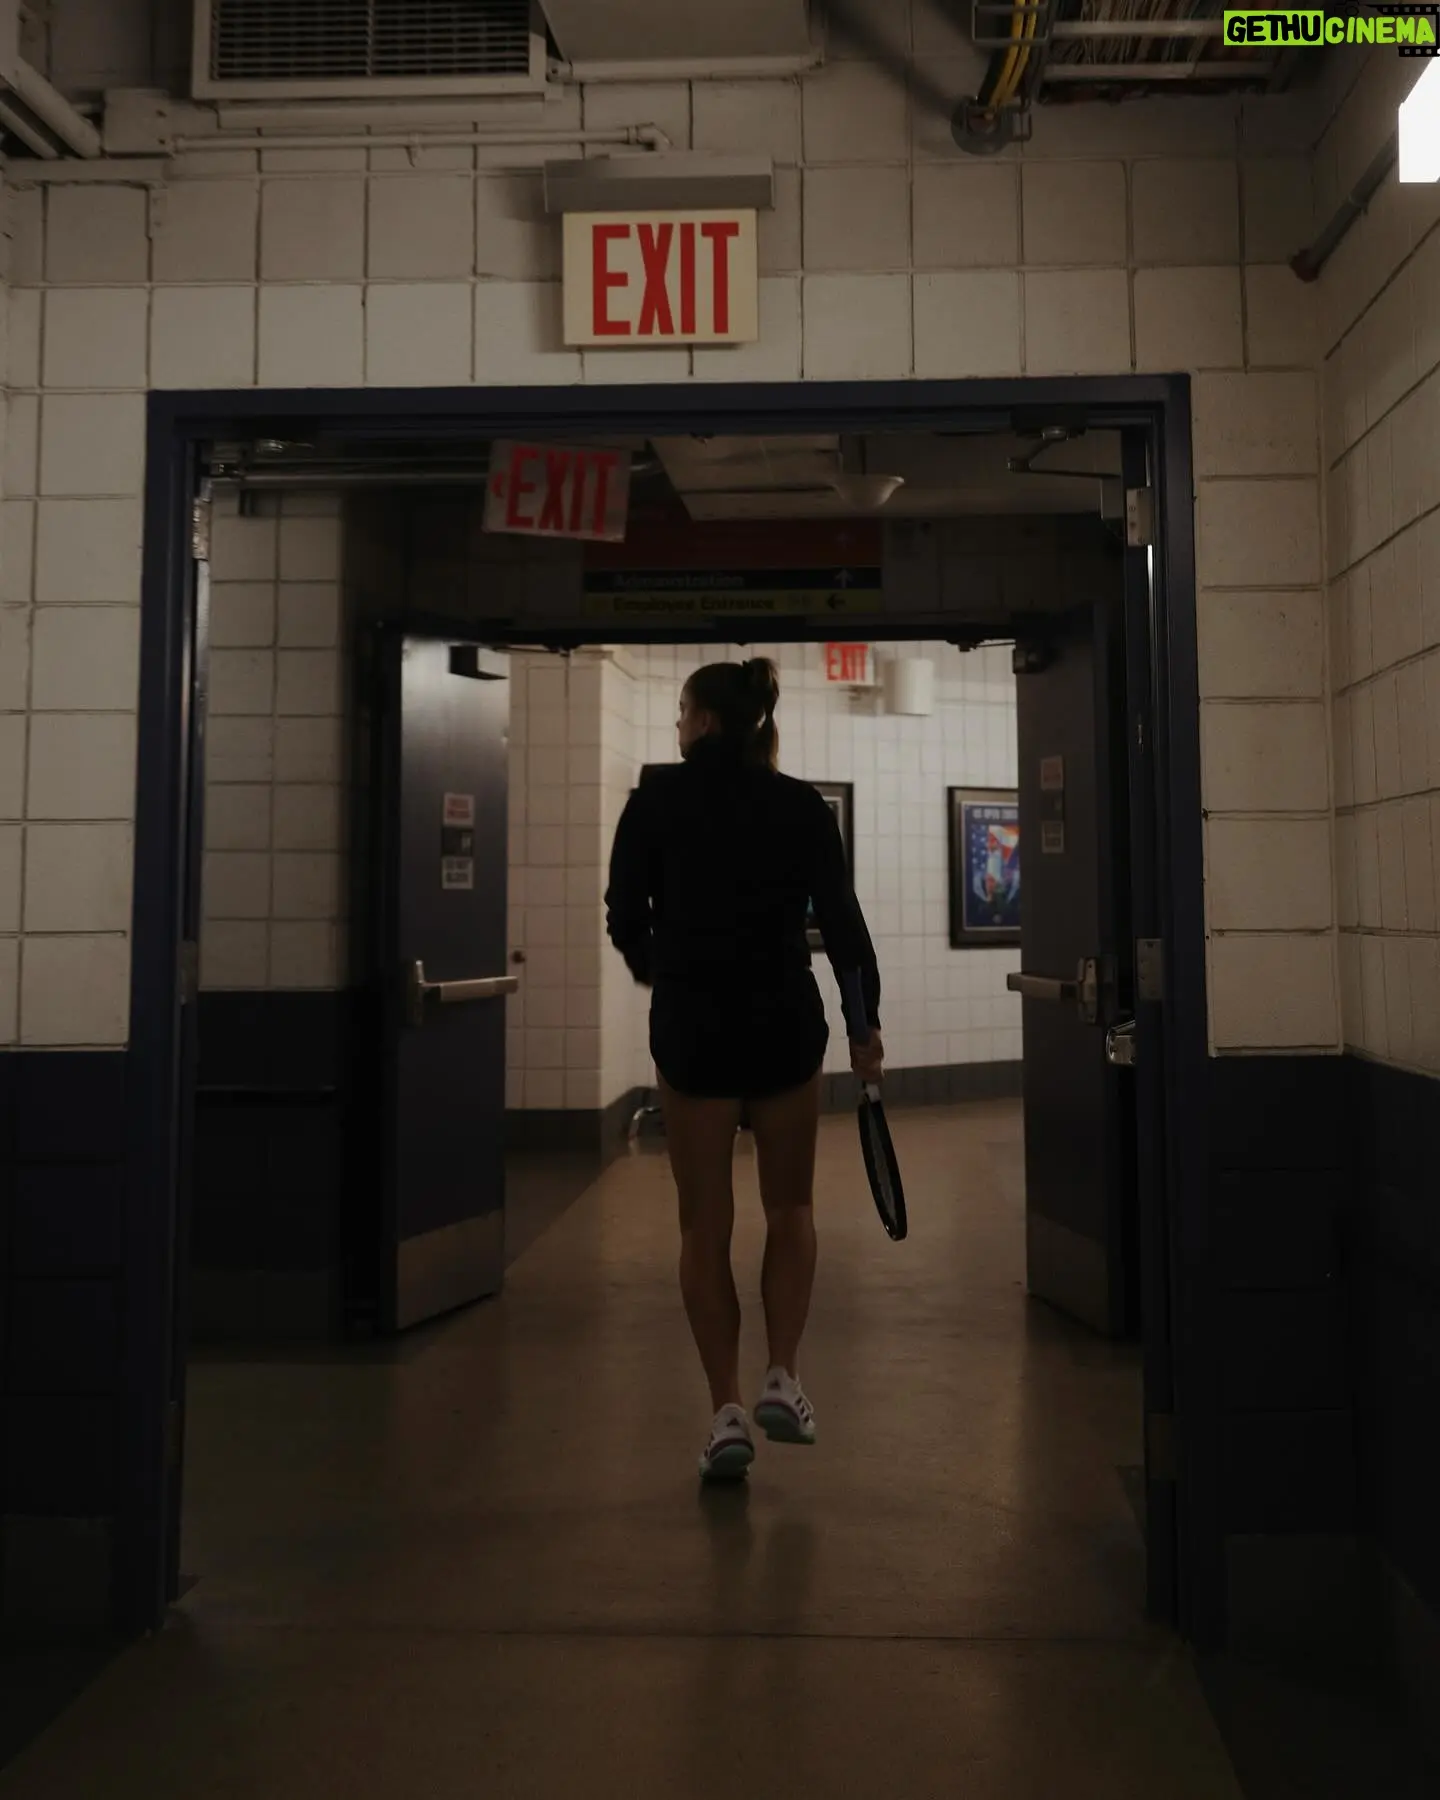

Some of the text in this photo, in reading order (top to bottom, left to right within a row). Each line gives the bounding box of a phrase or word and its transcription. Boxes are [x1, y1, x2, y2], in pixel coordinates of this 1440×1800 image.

[592, 222, 739, 336] EXIT
[506, 445, 619, 533] EXIT
[613, 572, 745, 588] Administration
[613, 596, 694, 613] Employee
[700, 596, 775, 610] Entrance
[826, 643, 868, 681] EXIT
